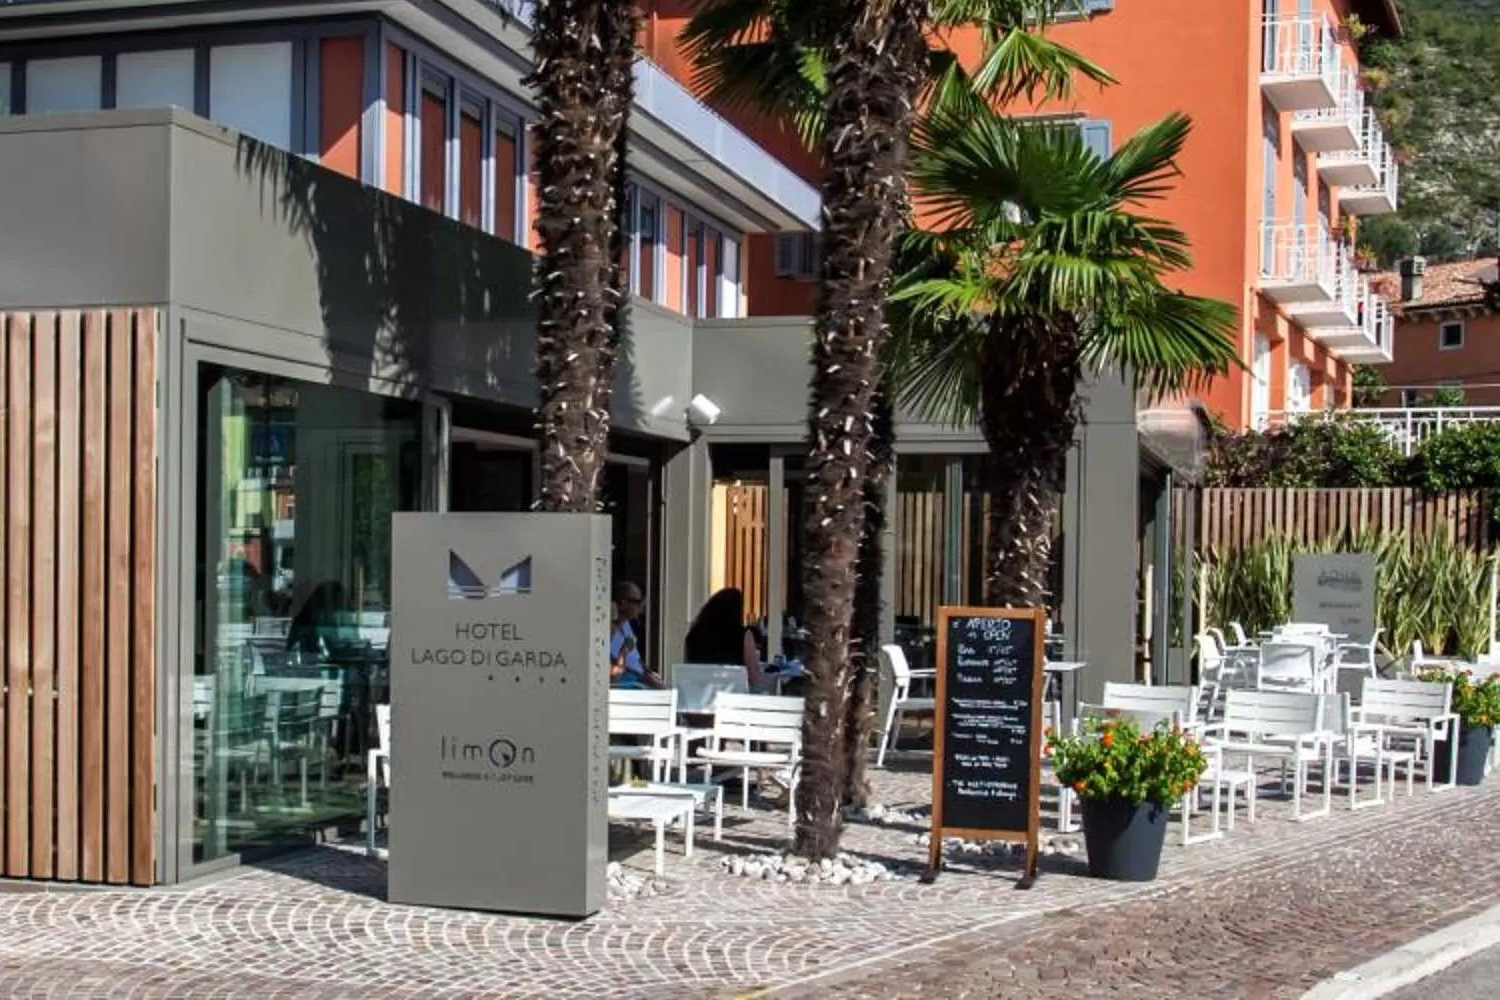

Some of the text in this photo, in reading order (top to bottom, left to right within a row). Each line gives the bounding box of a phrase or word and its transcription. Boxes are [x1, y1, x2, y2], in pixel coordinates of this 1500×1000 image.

[455, 622, 524, 641] HOTEL
[411, 647, 568, 669] LAGO DI GARDA
